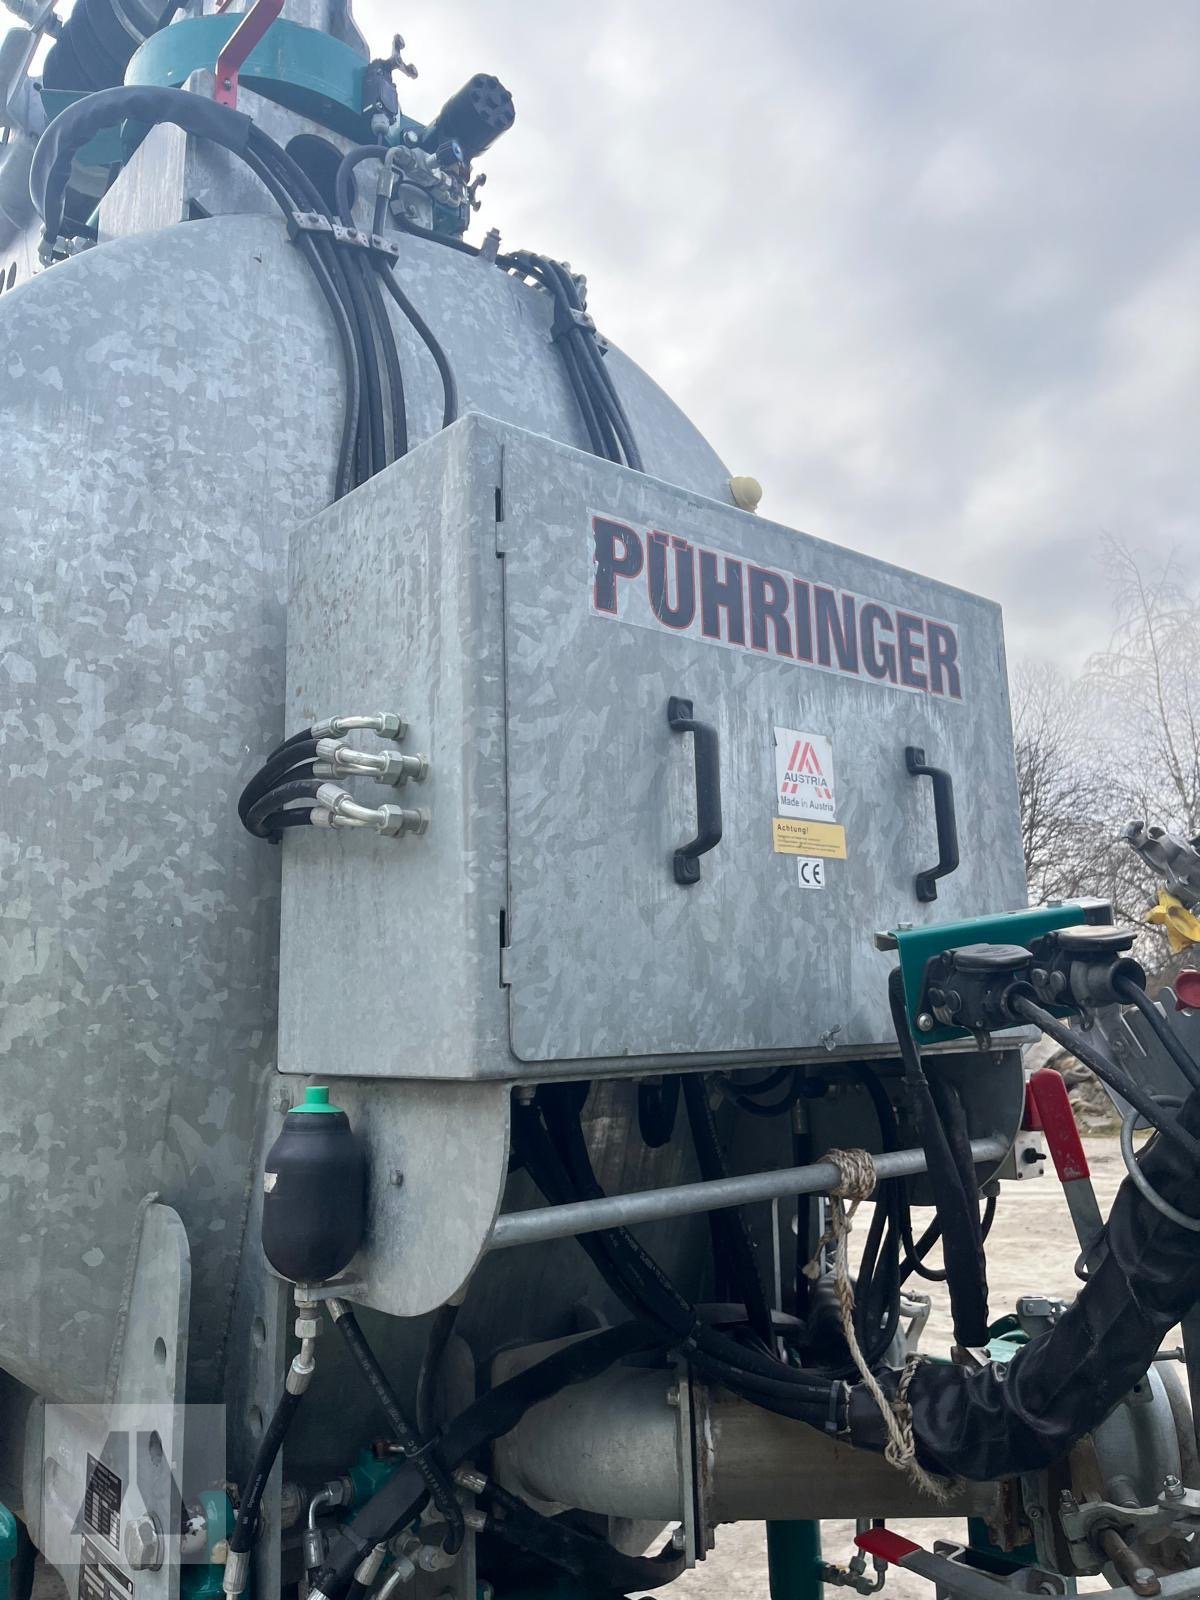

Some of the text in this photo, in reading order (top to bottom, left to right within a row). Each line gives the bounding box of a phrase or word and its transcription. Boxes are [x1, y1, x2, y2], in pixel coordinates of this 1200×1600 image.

[592, 515, 962, 700] PÜHRINGER
[784, 772, 827, 786] AUSTRIA
[781, 796, 833, 811] Made in Austria
[777, 823, 809, 835] Achtung!
[801, 862, 821, 884] CE
